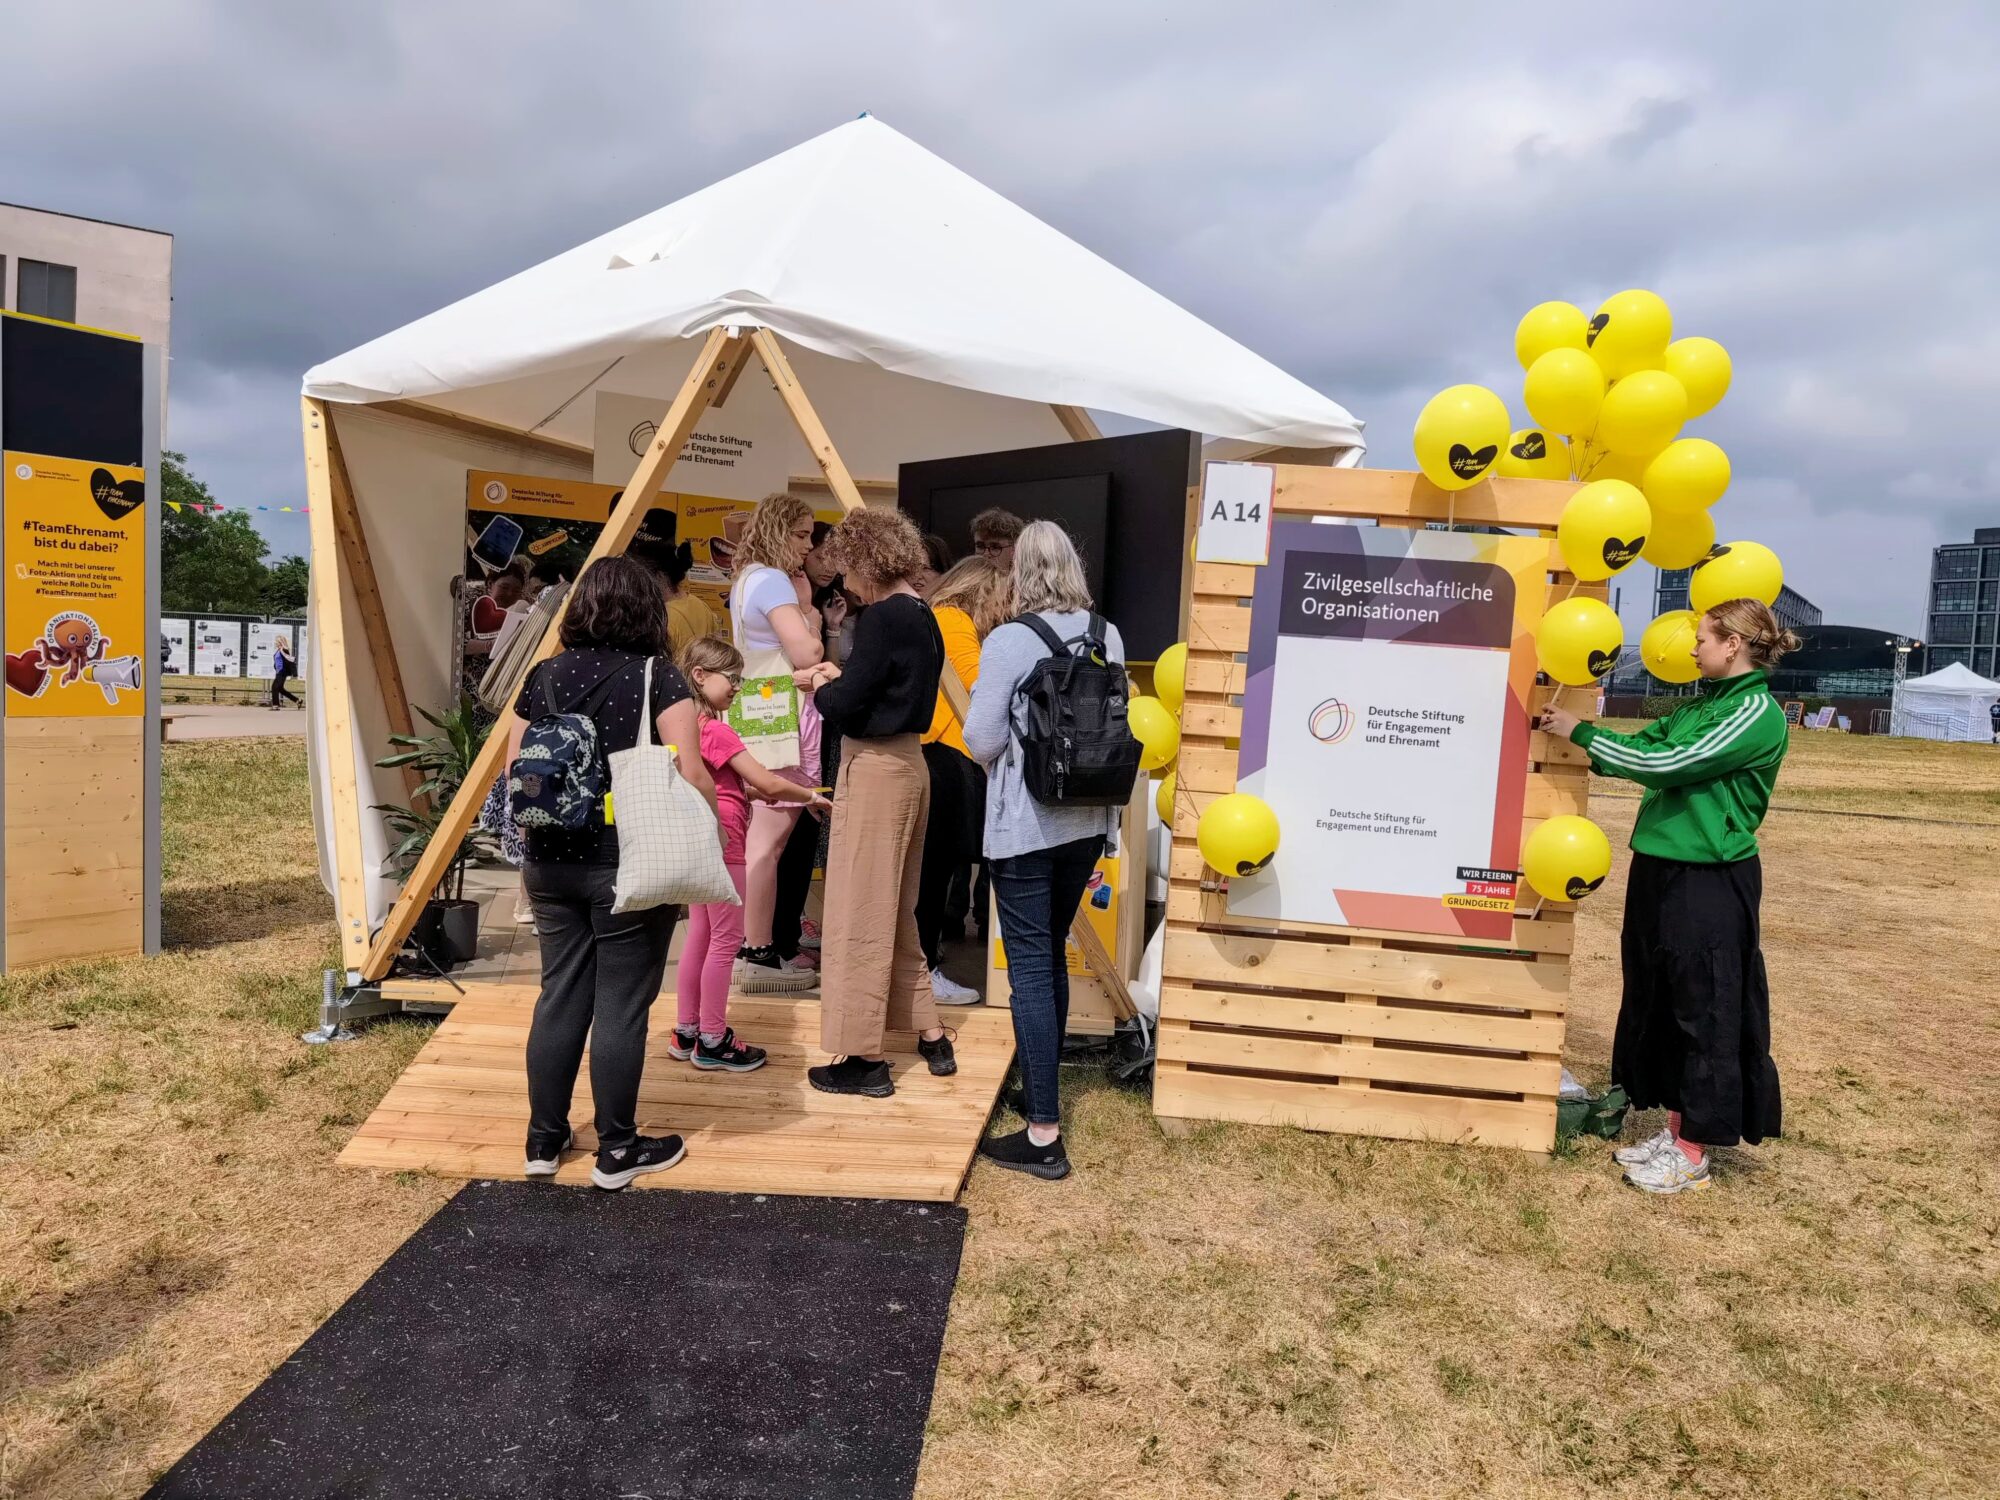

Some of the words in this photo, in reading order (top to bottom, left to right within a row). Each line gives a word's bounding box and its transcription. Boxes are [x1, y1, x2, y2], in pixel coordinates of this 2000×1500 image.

[689, 432, 718, 443] utsche
[719, 435, 753, 448] Stiftung
[691, 442, 743, 457] Engagement
[694, 454, 735, 467] Ehrenamt
[1210, 500, 1228, 521] A
[1234, 502, 1261, 523] 14
[23, 520, 129, 541] #TeamEhrenamt,
[34, 536, 58, 549] bist
[60, 538, 76, 550] du
[79, 540, 119, 553] dabei?
[37, 560, 59, 568] Mach
[60, 561, 73, 569] mit
[74, 562, 86, 570] bei
[29, 568, 76, 578] Foto-Aktion
[77, 571, 91, 579] und
[92, 572, 107, 581] zeig
[42, 579, 69, 587] welche
[70, 580, 90, 588] Rolle
[90, 581, 102, 589] Du
[102, 582, 112, 590] im
[1303, 571, 1494, 602] Zivilgesellschaftliche
[35, 588, 97, 598] #TeamEhrenamt
[98, 591, 118, 599] hast!
[1301, 597, 1440, 623] Organisationen
[47, 613, 99, 651] ORGANISATIONSTALENT
[1368, 706, 1419, 719] Deutsche
[1421, 710, 1465, 724] Stiftung
[1367, 719, 1383, 730] für
[1385, 720, 1452, 735] Engagement
[1365, 734, 1386, 744] und
[1388, 734, 1441, 748] Ehrenamt
[1329, 808, 1372, 820] Deutsche
[1373, 812, 1410, 825] Stiftung
[1412, 815, 1427, 825] für
[1316, 819, 1372, 832] Engagement
[1373, 824, 1391, 834] und
[1393, 825, 1438, 838] Ehrenamt
[1462, 869, 1480, 879] WIR
[1481, 871, 1513, 881] FEIERN
[1471, 884, 1482, 893] 75
[1484, 886, 1511, 896] JAHRE
[1447, 896, 1510, 910] GRUNDGESETZ
